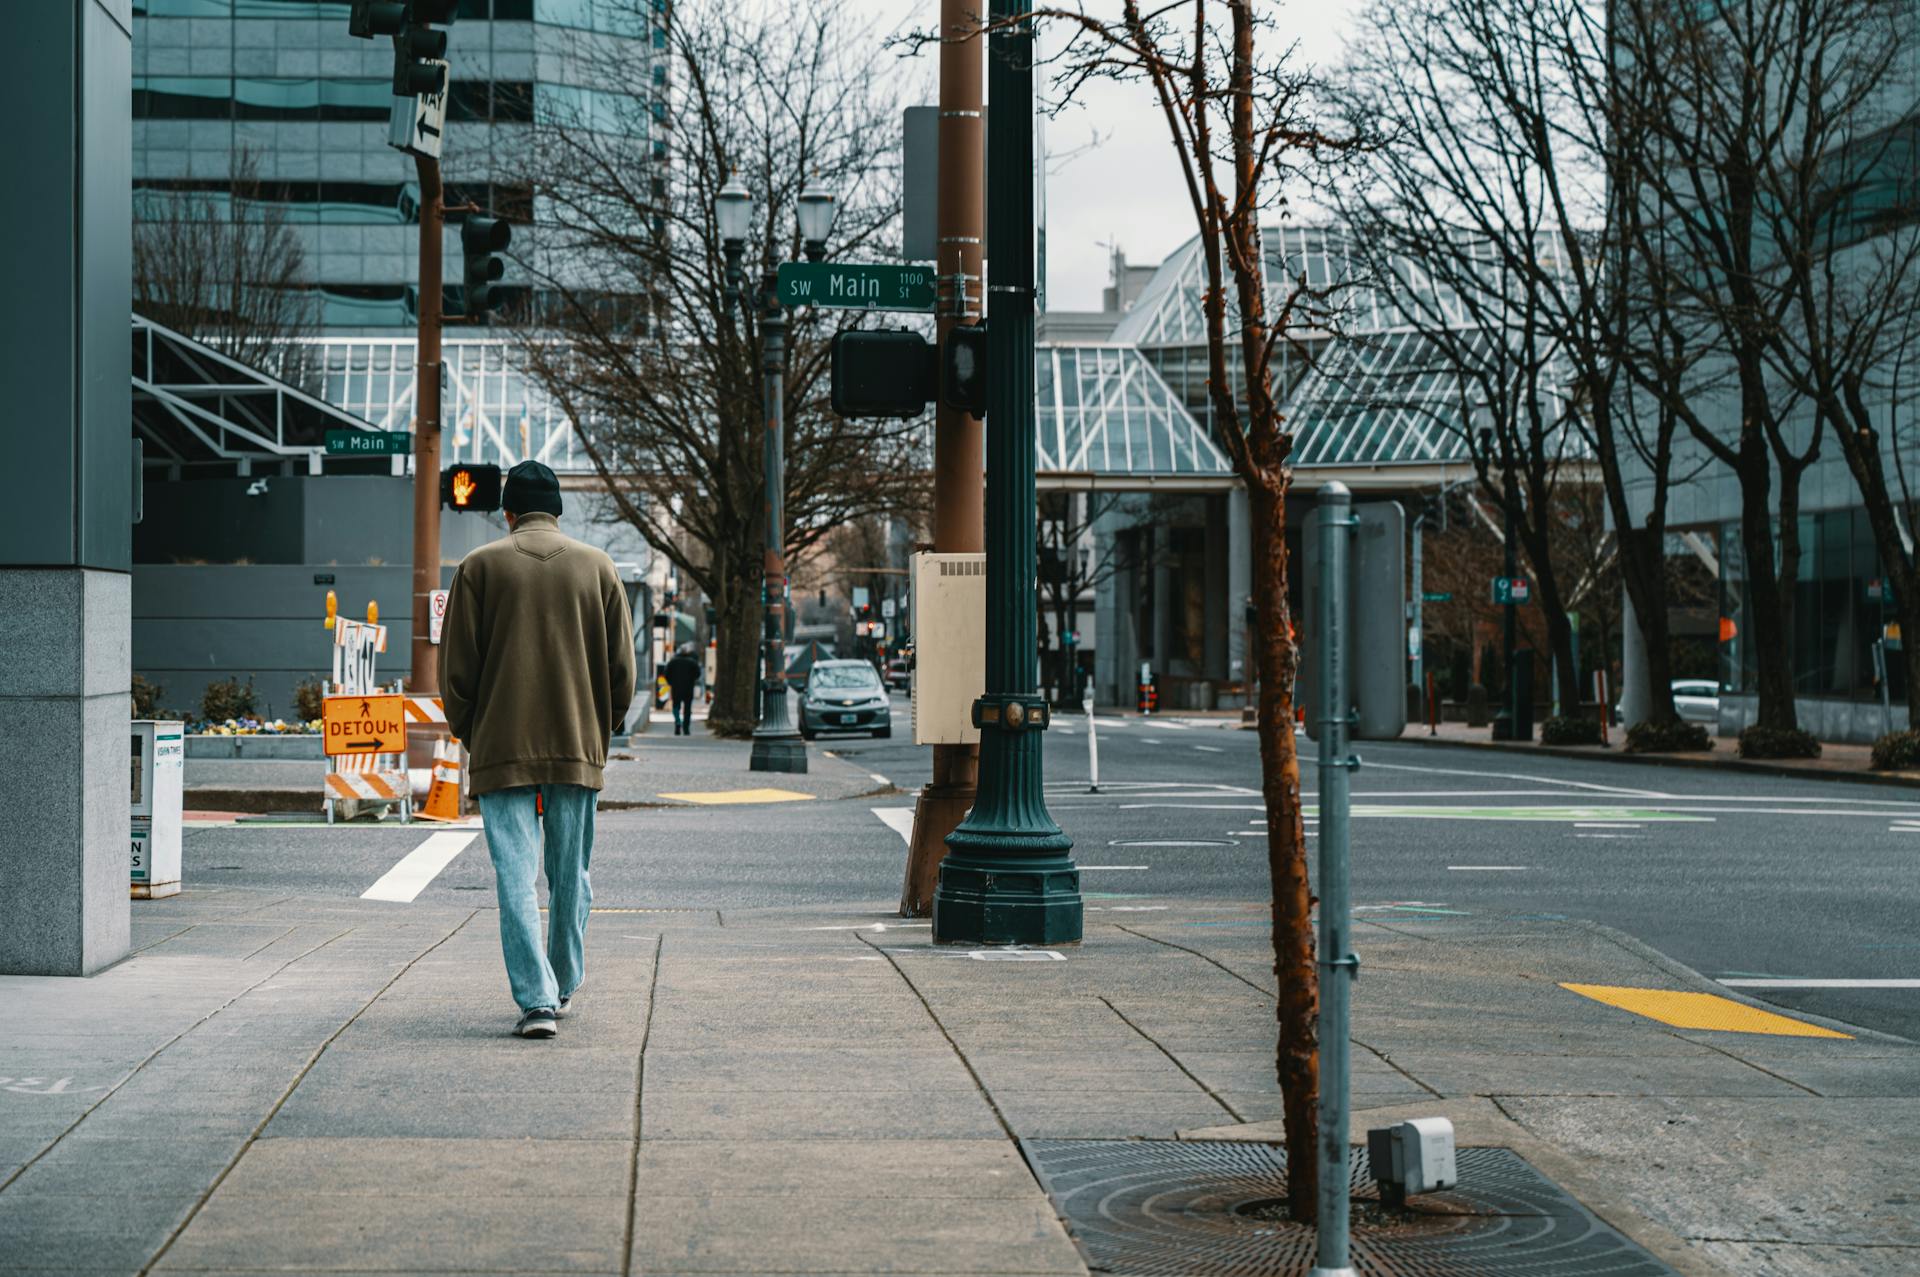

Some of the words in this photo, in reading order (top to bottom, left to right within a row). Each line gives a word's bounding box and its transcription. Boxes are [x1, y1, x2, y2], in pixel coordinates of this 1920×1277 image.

[790, 279, 812, 296] SW
[829, 272, 880, 297] Main
[900, 273, 924, 285] 1100
[899, 286, 910, 299] St
[332, 439, 344, 449] SW
[350, 435, 384, 450] Main
[331, 720, 399, 736] DETOUR
